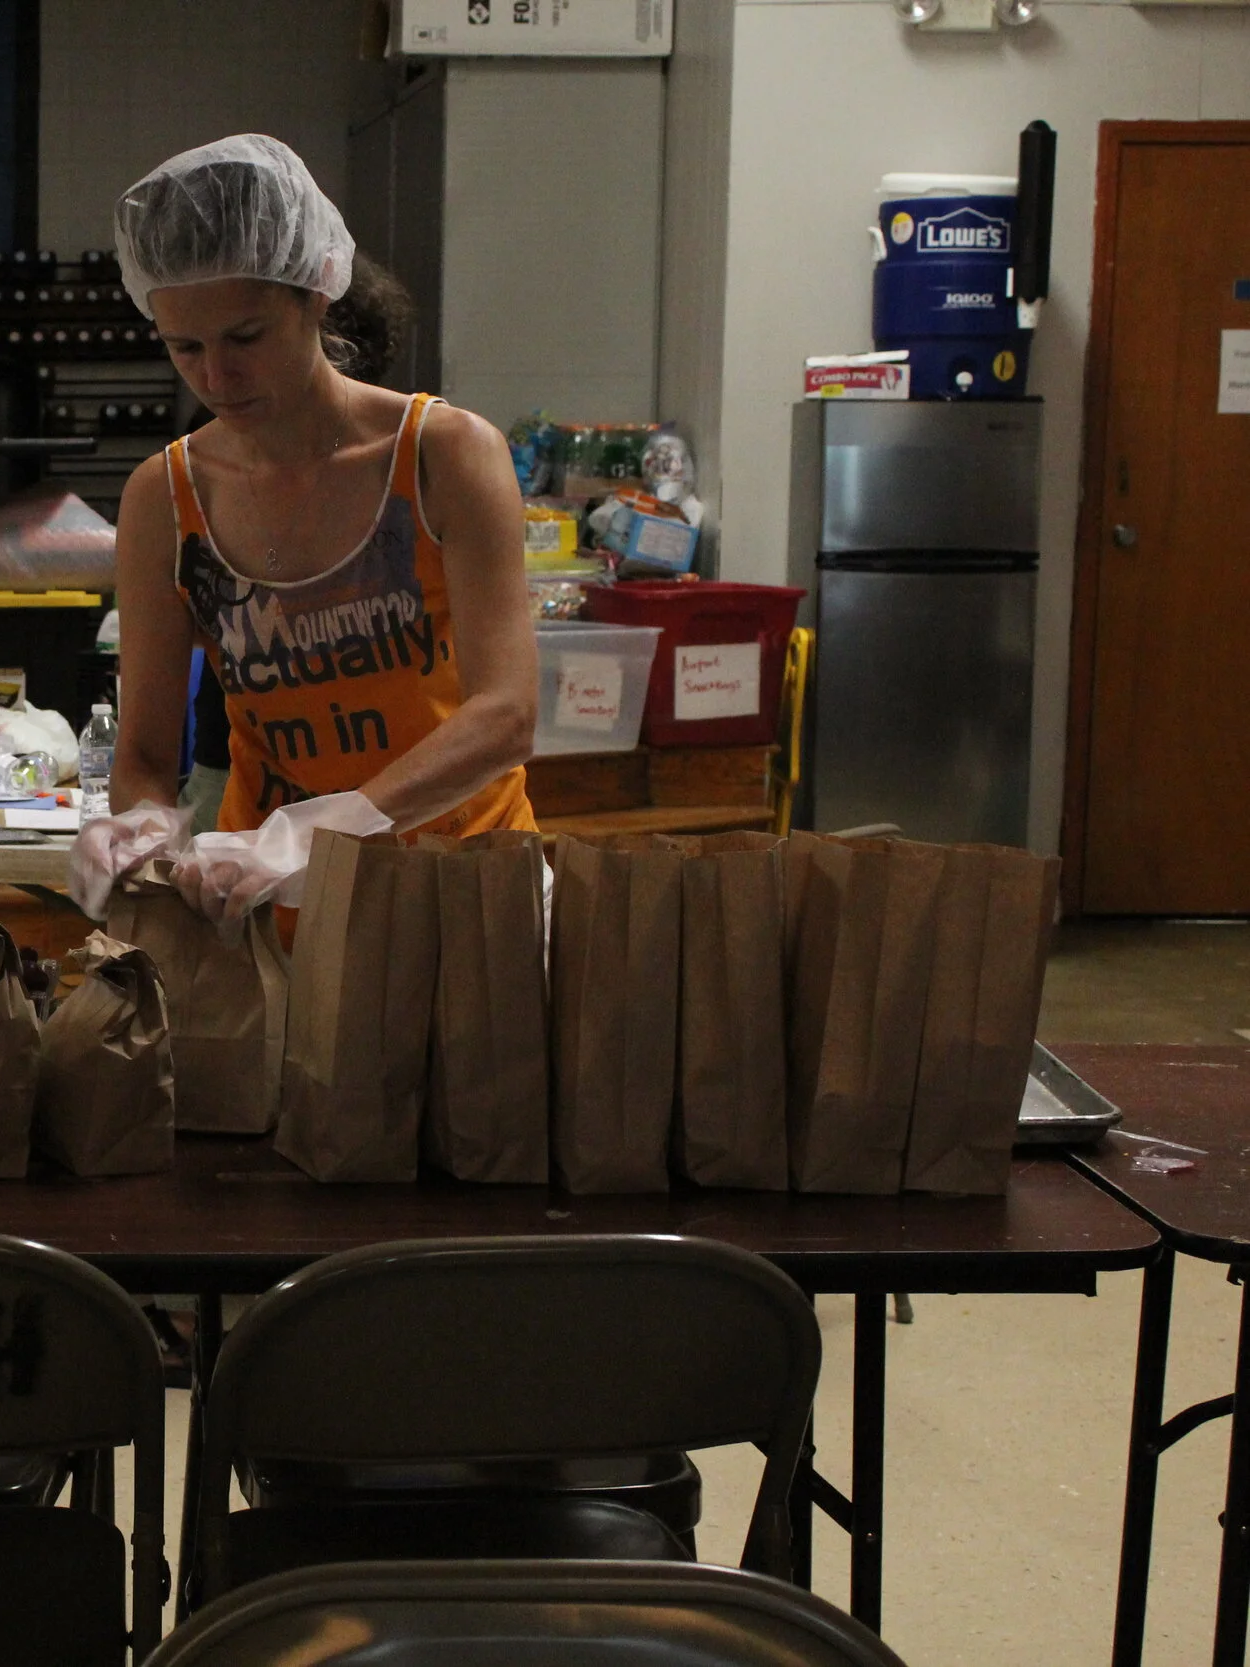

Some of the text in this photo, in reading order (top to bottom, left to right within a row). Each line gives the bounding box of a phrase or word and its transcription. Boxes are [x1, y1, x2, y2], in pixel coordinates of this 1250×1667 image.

[513, 0, 530, 24] FO
[926, 223, 1002, 248] LOWE'S
[329, 702, 389, 755] in
